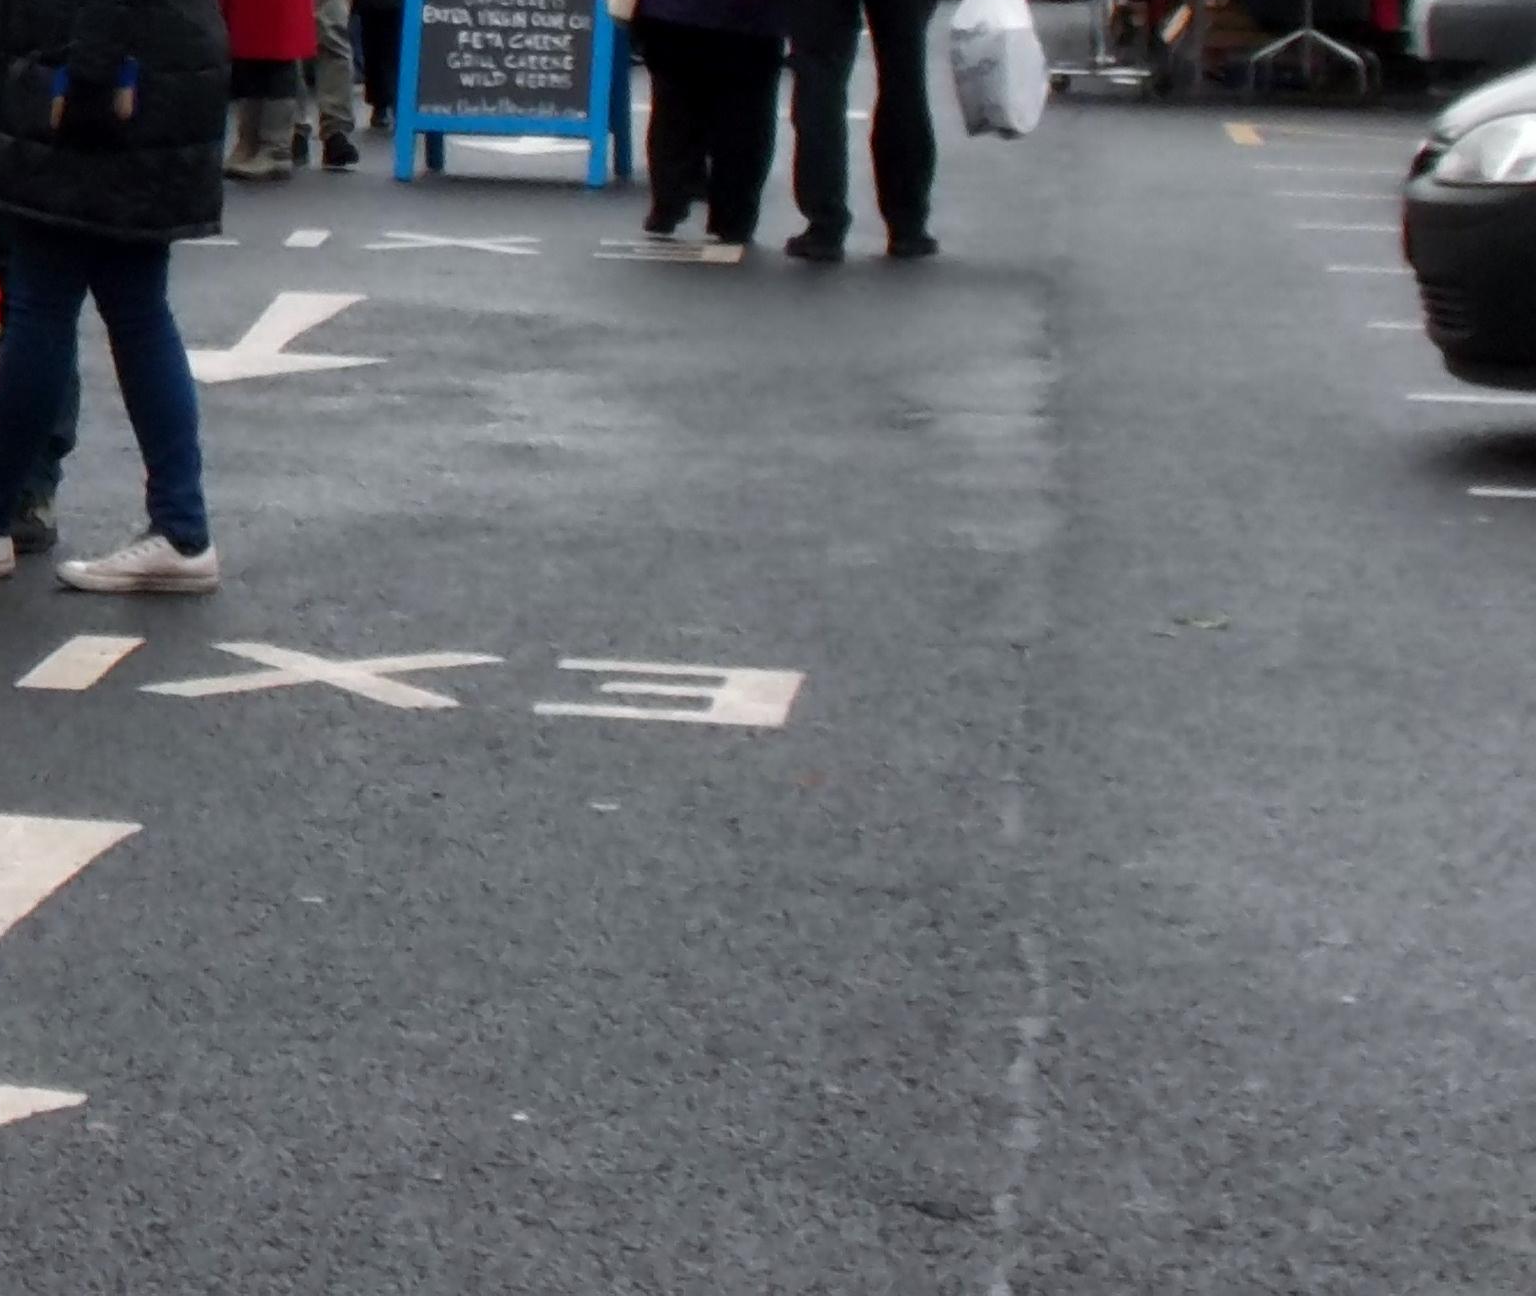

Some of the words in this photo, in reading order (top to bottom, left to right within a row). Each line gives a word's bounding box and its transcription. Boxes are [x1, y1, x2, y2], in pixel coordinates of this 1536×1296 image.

[457, 30, 504, 51] FETA
[504, 54, 576, 71] CHEESE
[459, 71, 508, 88] WILD
